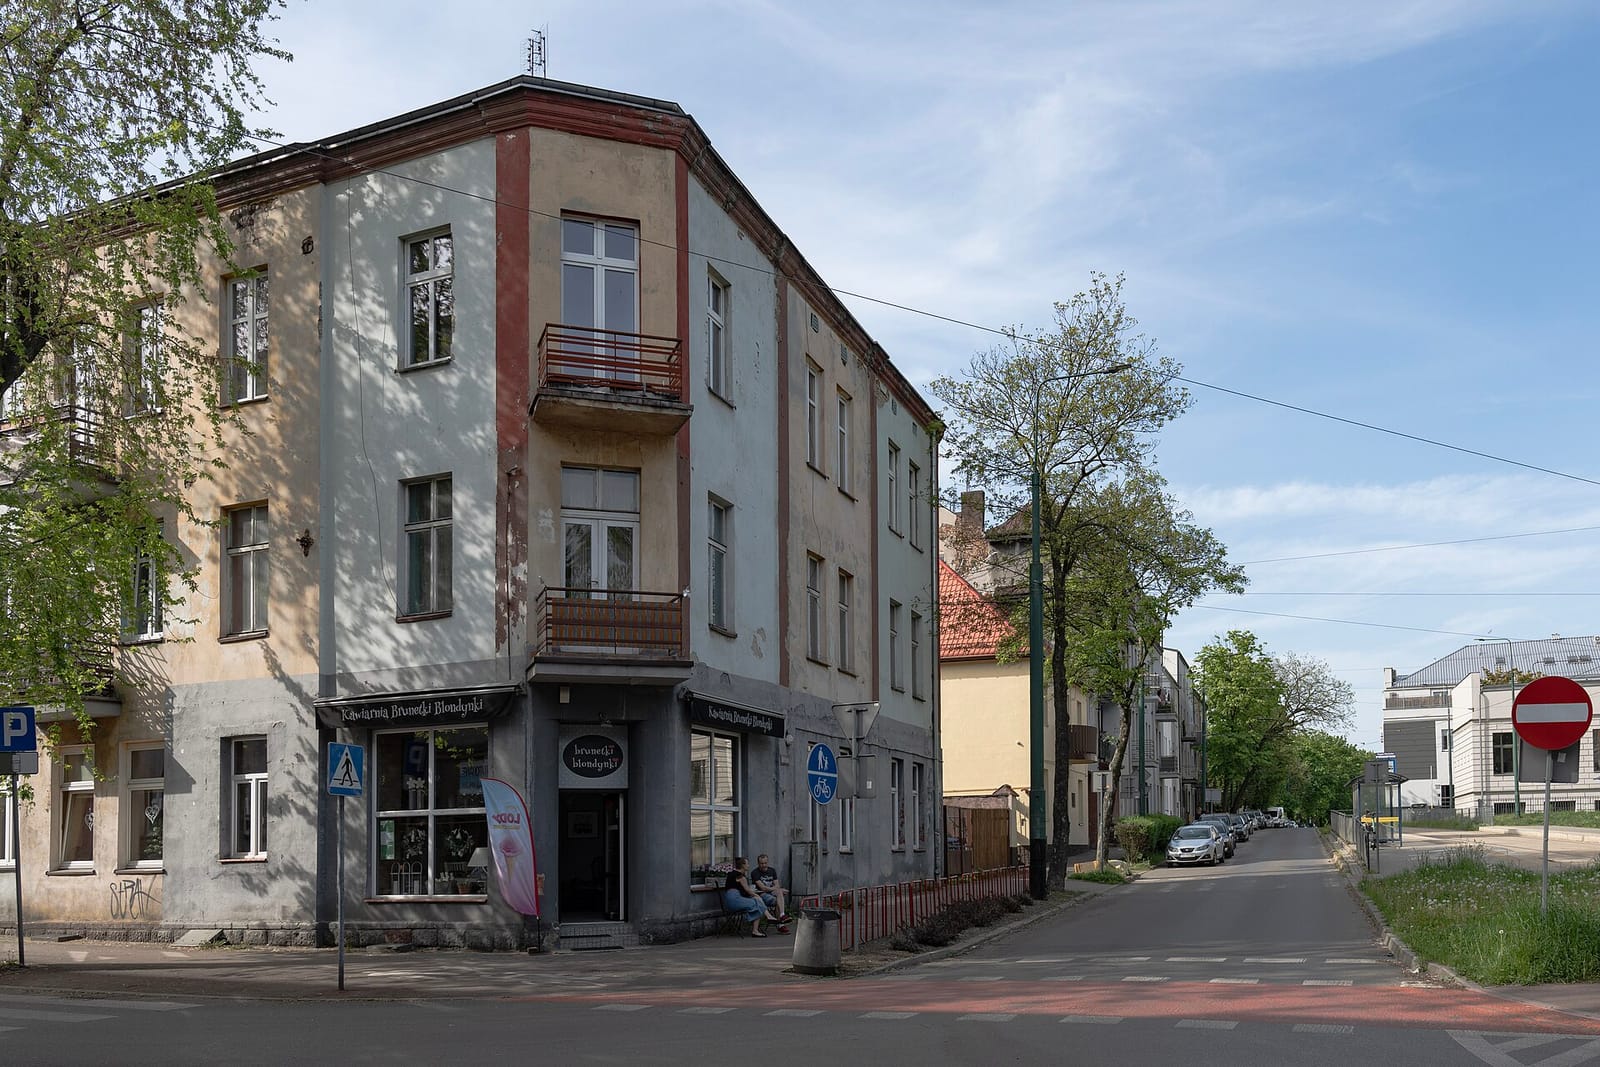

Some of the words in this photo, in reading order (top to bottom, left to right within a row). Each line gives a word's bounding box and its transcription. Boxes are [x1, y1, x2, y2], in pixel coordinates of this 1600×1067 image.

[341, 708, 389, 721] Kawiarnia
[391, 702, 432, 719] Brunetki
[434, 697, 483, 718] Blondynki
[3, 712, 28, 747] P
[574, 744, 614, 756] brunetki
[572, 757, 618, 771] blondynki
